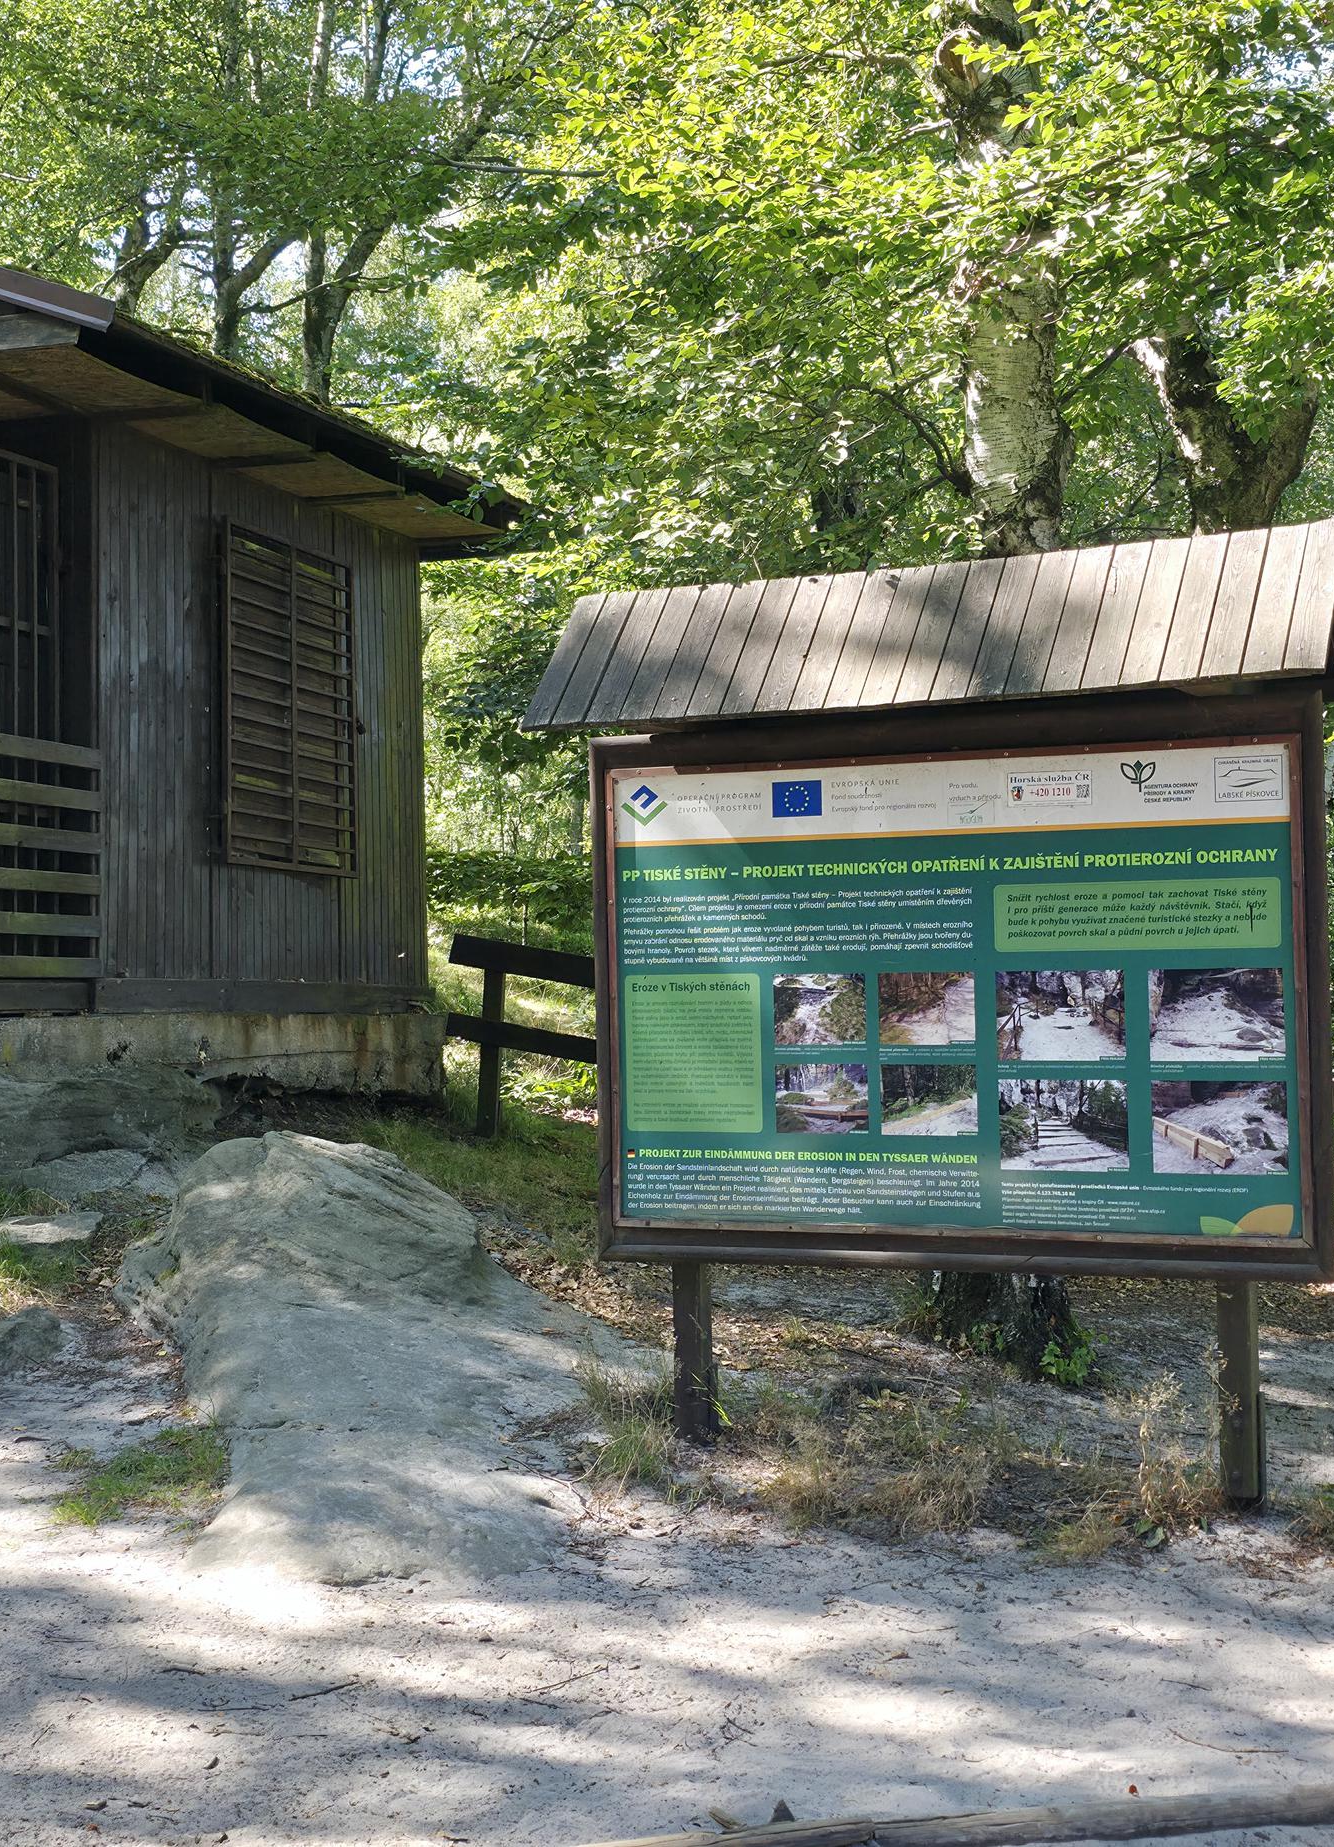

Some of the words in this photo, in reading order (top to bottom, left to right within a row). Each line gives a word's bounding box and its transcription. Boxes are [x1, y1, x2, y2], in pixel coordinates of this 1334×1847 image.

[1075, 772, 1089, 780] ČR
[831, 779, 875, 788] EVROPSKÁ
[677, 793, 719, 801] OPERAČNÍ
[722, 792, 761, 800] PROGRAM
[1030, 788, 1049, 796] +420
[1052, 787, 1071, 796] 1210
[1218, 791, 1243, 799] LABSKÉ
[1245, 790, 1279, 798] PÍSKOVCE
[623, 870, 640, 881] PP
[643, 866, 681, 881] TISKÉ
[684, 864, 727, 880] STĚNY
[743, 865, 804, 878] PROJEKT
[808, 858, 907, 876] TECHNICKÝCH
[911, 855, 985, 872] OPATŘENÍ
[989, 858, 1000, 870] K
[1003, 852, 1079, 870] ZAJIŠTĚNÍ
[1084, 848, 1192, 867] PROTIEROZNÍ
[1196, 848, 1278, 863] OCHRANY
[623, 896, 628, 904] V
[644, 895, 661, 903] 2014
[663, 895, 671, 904] byl
[674, 894, 705, 902] realizován
[707, 893, 729, 903] projekt
[761, 892, 790, 902] památka
[793, 891, 809, 899] Tiské
[811, 891, 829, 900] stěny
[838, 890, 861, 899] Projekt
[864, 889, 903, 898] technických
[906, 888, 934, 898] opatření
[943, 887, 972, 896] zajištění
[1007, 894, 1031, 902] Snížit
[1035, 893, 1070, 903] rychlost
[1168, 889, 1209, 898] zachovat
[1213, 888, 1237, 896] Tiské
[1241, 888, 1267, 898] stěny
[1013, 907, 1028, 916] pro
[1032, 905, 1055, 915] příští
[1058, 906, 1098, 914] generace
[1102, 903, 1126, 912] může
[1130, 902, 1155, 912] každý
[1159, 902, 1211, 910] návštěvník.
[1215, 900, 1241, 910] Stačí,
[1008, 918, 1028, 926] bude
[1039, 917, 1069, 927] pohybu
[1072, 916, 1107, 926] využívat
[1108, 914, 1146, 924] značené
[1148, 914, 1190, 923] turistické
[1193, 914, 1223, 923] stezky
[1008, 929, 1056, 939] poškozovat
[1058, 928, 1087, 938] povrch
[1089, 928, 1108, 937] skal
[1118, 927, 1143, 937] půdní
[1145, 926, 1175, 936] povrch
[1185, 925, 1210, 936] jejich
[1213, 924, 1239, 935] úpatí.
[632, 983, 658, 992] Eroze
[661, 984, 666, 992] v
[669, 982, 706, 994] Tiských
[709, 981, 750, 993] stěnách
[639, 1149, 680, 1158] PROJEKT
[683, 1149, 701, 1158] ZUR
[705, 1148, 772, 1160] EINDÄMMUNG
[775, 1151, 795, 1160] DER
[798, 1152, 843, 1161] EROSION
[845, 1153, 856, 1161] IN
[859, 1153, 879, 1162] DEN
[882, 1154, 928, 1163] TYSSAER
[931, 1152, 978, 1164] WÄNDEN
[628, 1162, 637, 1170] Die
[677, 1164, 742, 1172] Sandsteinlandschaft
[760, 1165, 778, 1173] durch
[781, 1166, 814, 1174] natürliche
[816, 1166, 837, 1174] Kräfte
[839, 1167, 865, 1176] (Regen,
[867, 1168, 886, 1176] Wind,
[888, 1168, 907, 1176] Frost,
[949, 1169, 979, 1177] Verwitte-
